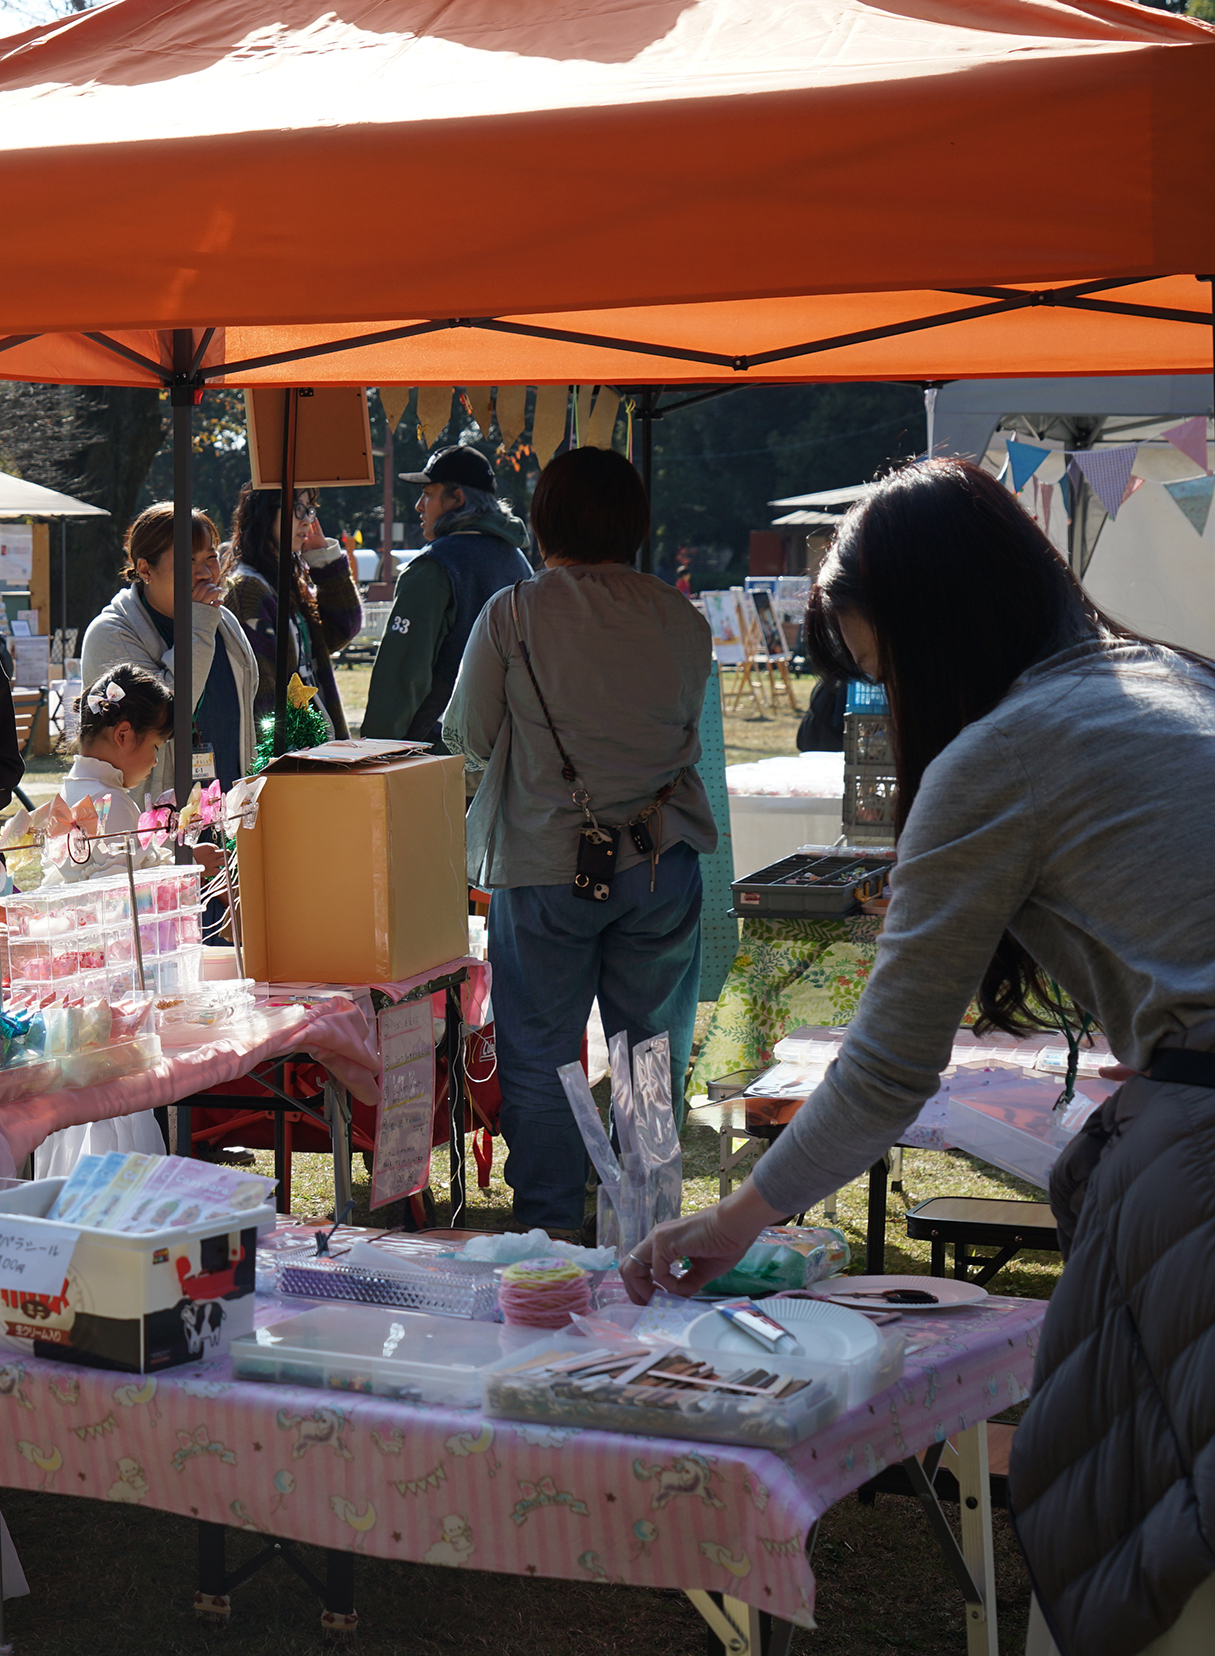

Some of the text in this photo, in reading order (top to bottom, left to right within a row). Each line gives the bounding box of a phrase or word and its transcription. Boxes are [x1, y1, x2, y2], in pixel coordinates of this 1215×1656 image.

[391, 615, 411, 634] 33
[14, 1324, 62, 1342] 生クリーム入り
